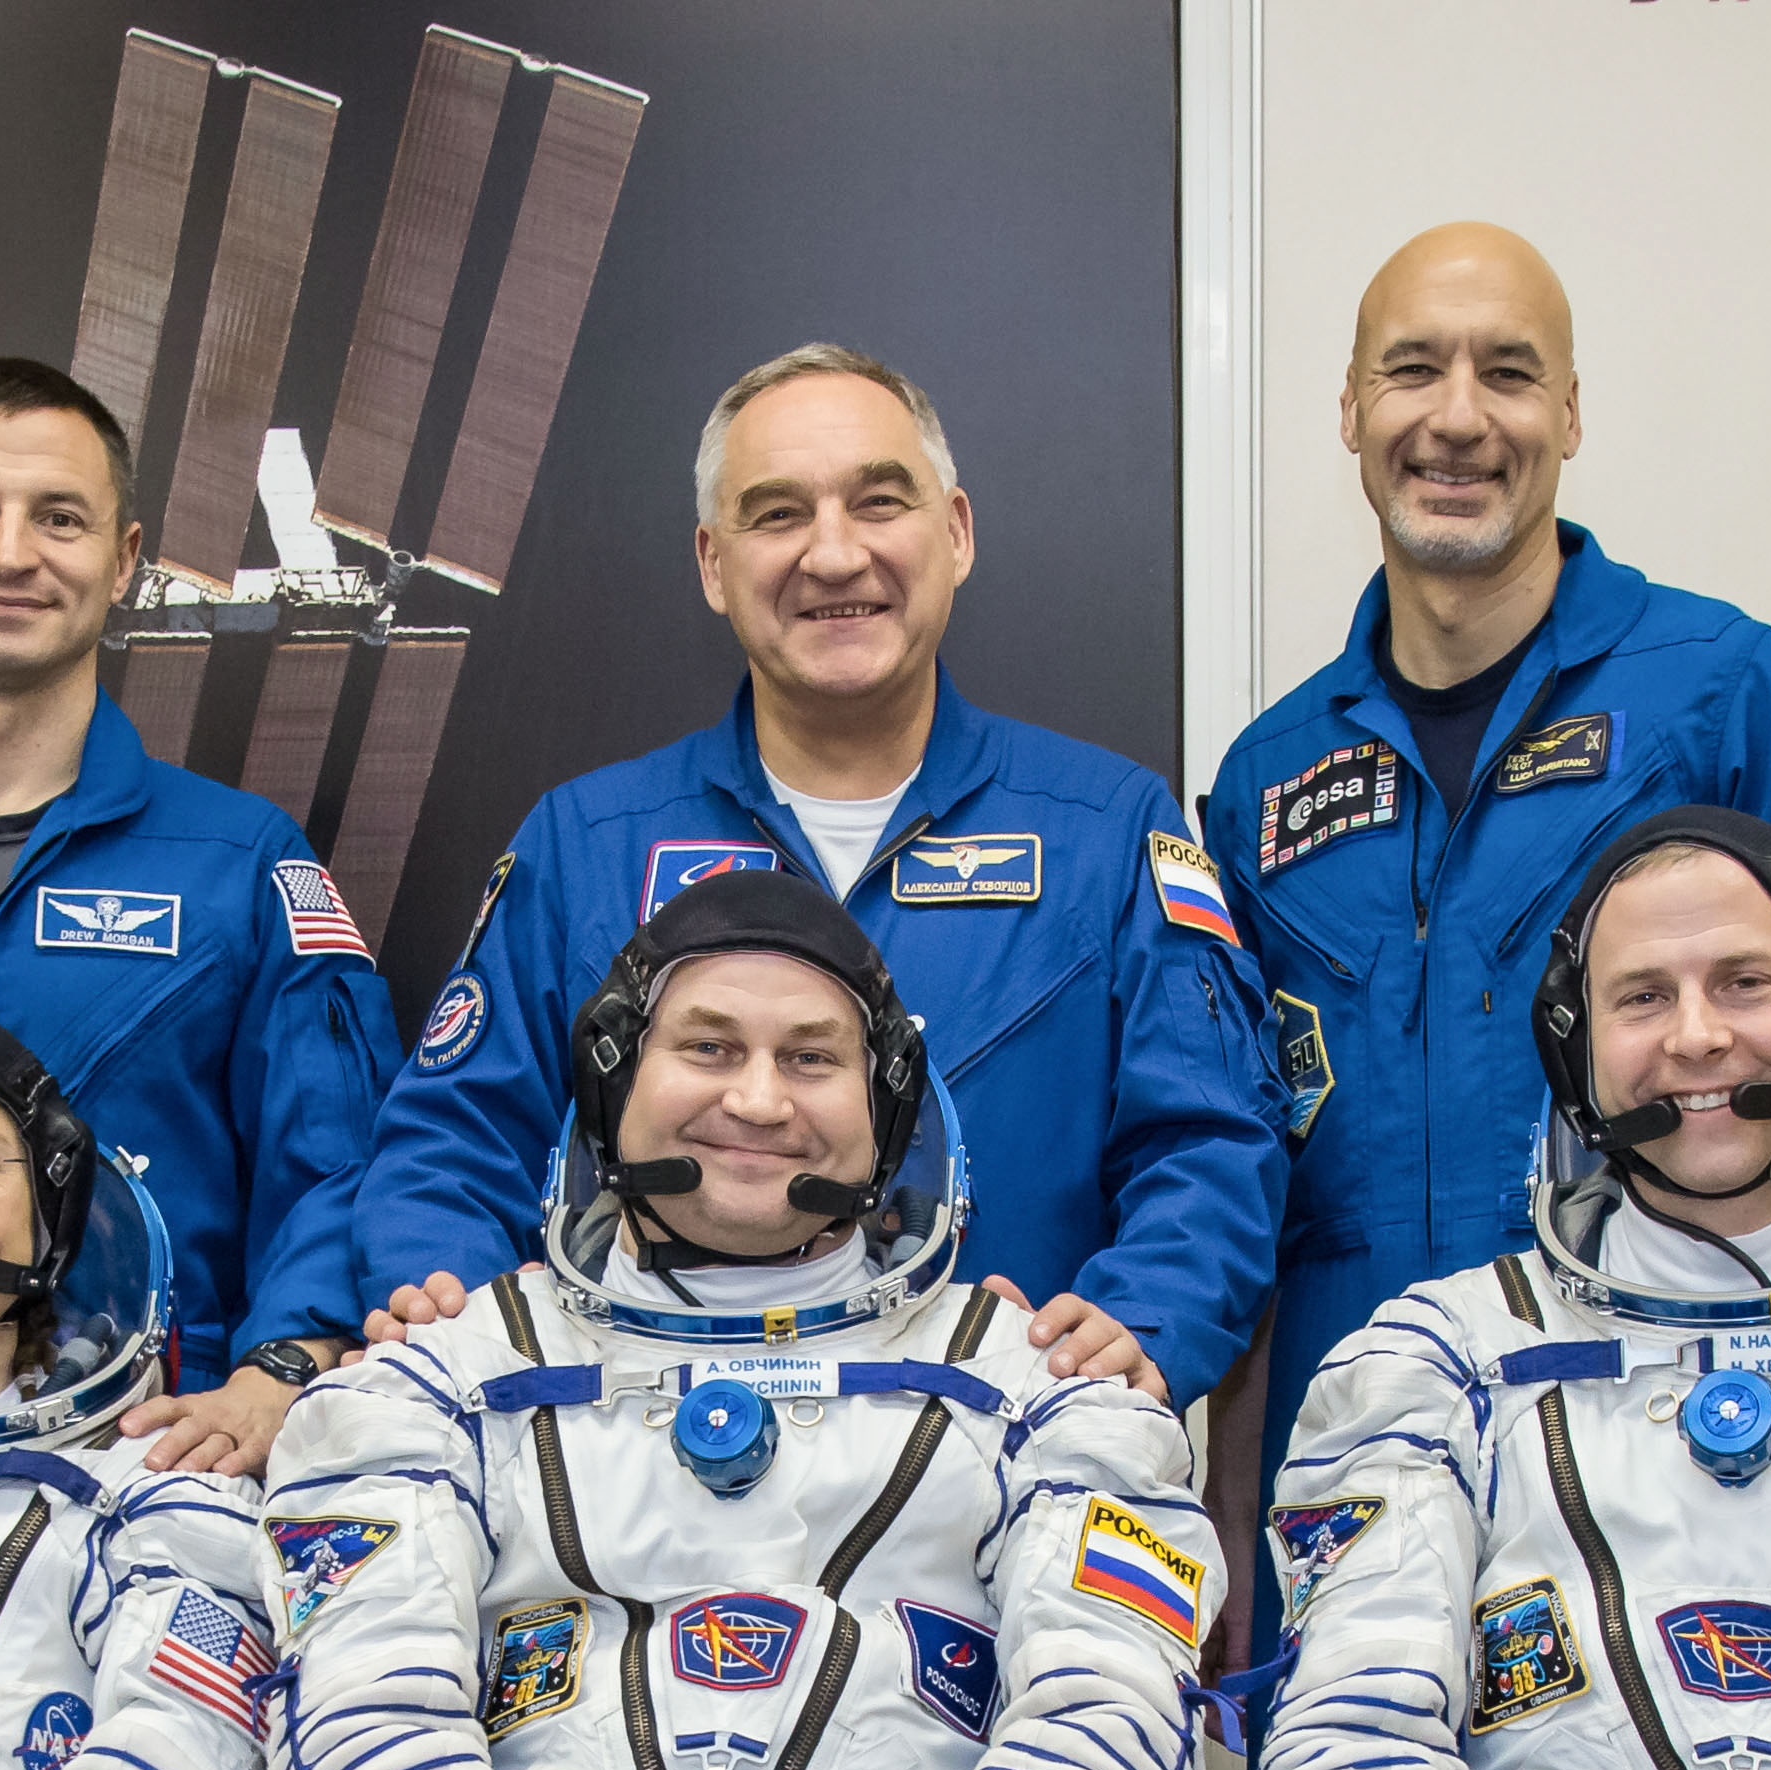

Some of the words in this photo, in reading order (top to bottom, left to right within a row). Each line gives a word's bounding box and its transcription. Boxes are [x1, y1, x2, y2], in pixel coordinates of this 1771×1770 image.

[1509, 770, 1534, 783] LUCA
[902, 882, 968, 893] АЛЕКСАНДР
[972, 881, 1030, 893] СКВОРЦОВ
[60, 929, 95, 941] DREW
[102, 933, 154, 947] MORGAN
[1730, 1336, 1745, 1349] N.
[707, 1361, 724, 1373] А.
[730, 1358, 821, 1372] ОВЧИНИН
[1093, 1506, 1196, 1586] РОССИЯ
[926, 1666, 981, 1716] РОСКОСМОС
